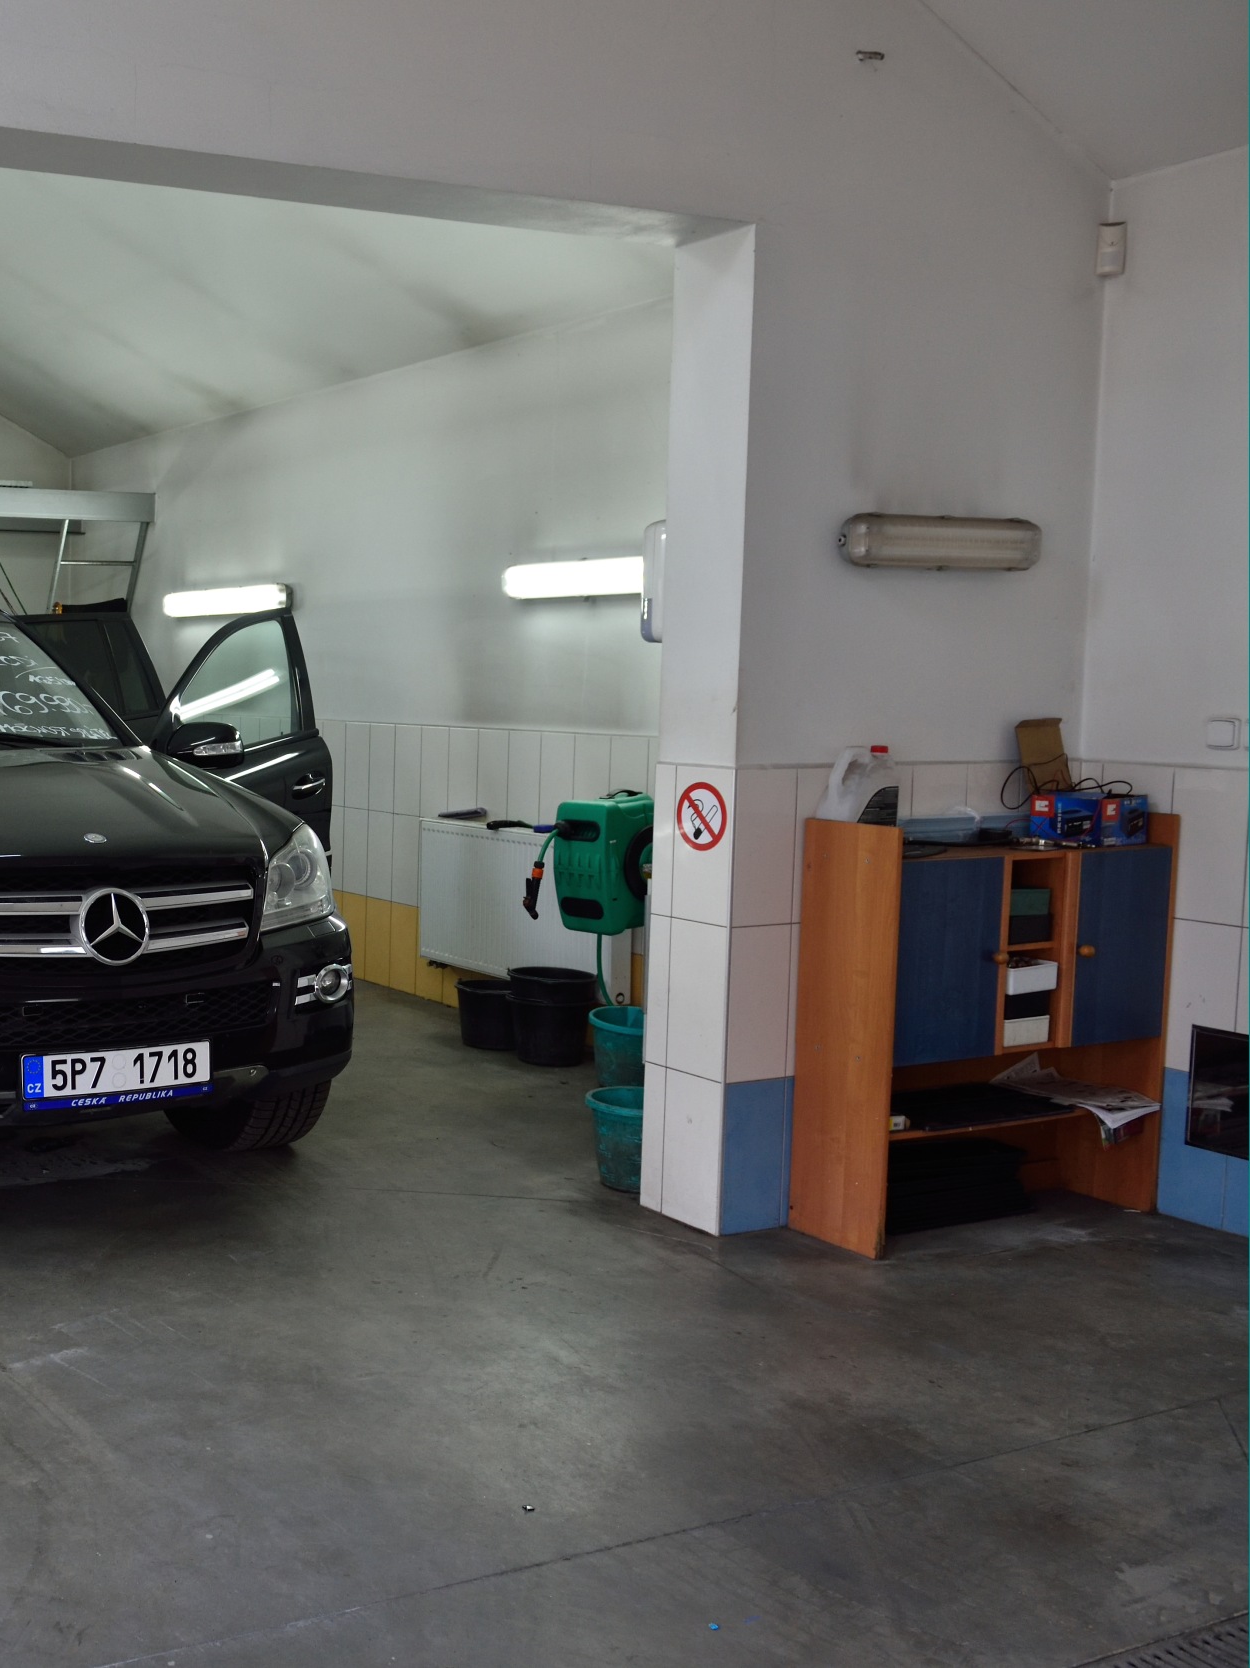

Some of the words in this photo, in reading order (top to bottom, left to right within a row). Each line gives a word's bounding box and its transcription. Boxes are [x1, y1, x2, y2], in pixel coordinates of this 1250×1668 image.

[51, 1056, 106, 1091] 5P7
[133, 1048, 197, 1084] 1718
[27, 1083, 42, 1093] CZ
[118, 1089, 173, 1102] REPUBLIKA
